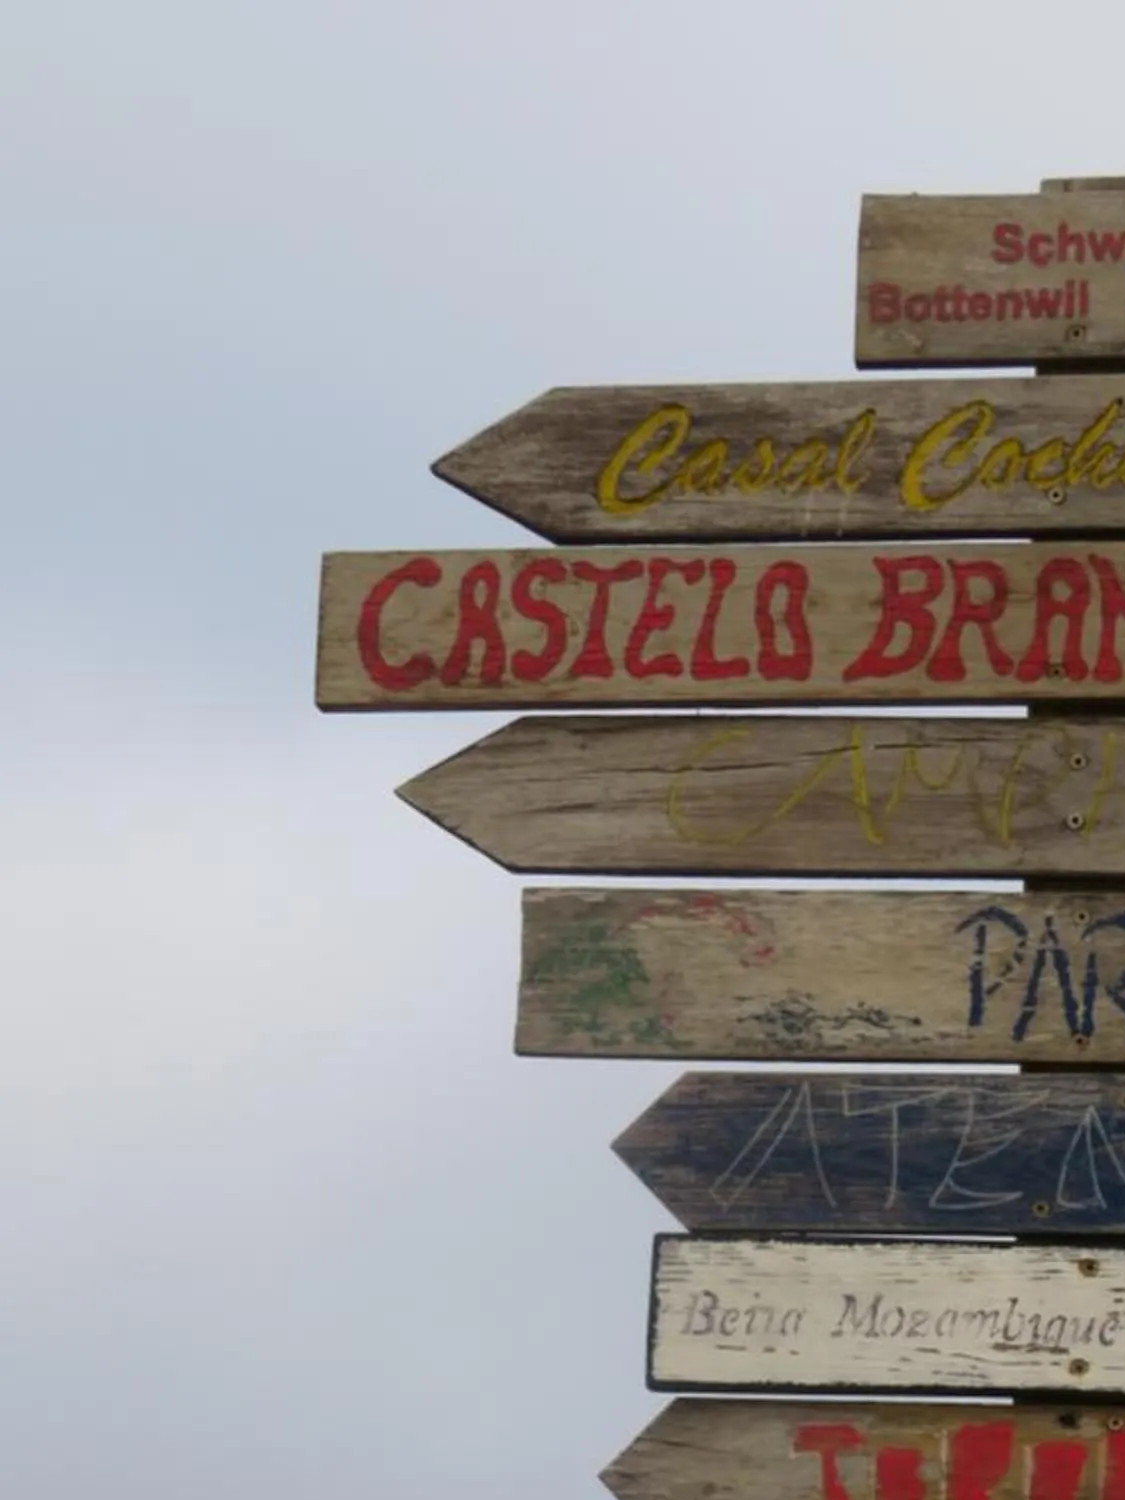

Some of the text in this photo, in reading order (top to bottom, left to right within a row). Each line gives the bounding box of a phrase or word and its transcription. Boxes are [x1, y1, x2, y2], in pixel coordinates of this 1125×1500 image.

[868, 280, 1090, 325] Bottenwil
[594, 402, 878, 515] Casal
[362, 553, 812, 690] CASTELO
[830, 1294, 1124, 1350] Mozambique
